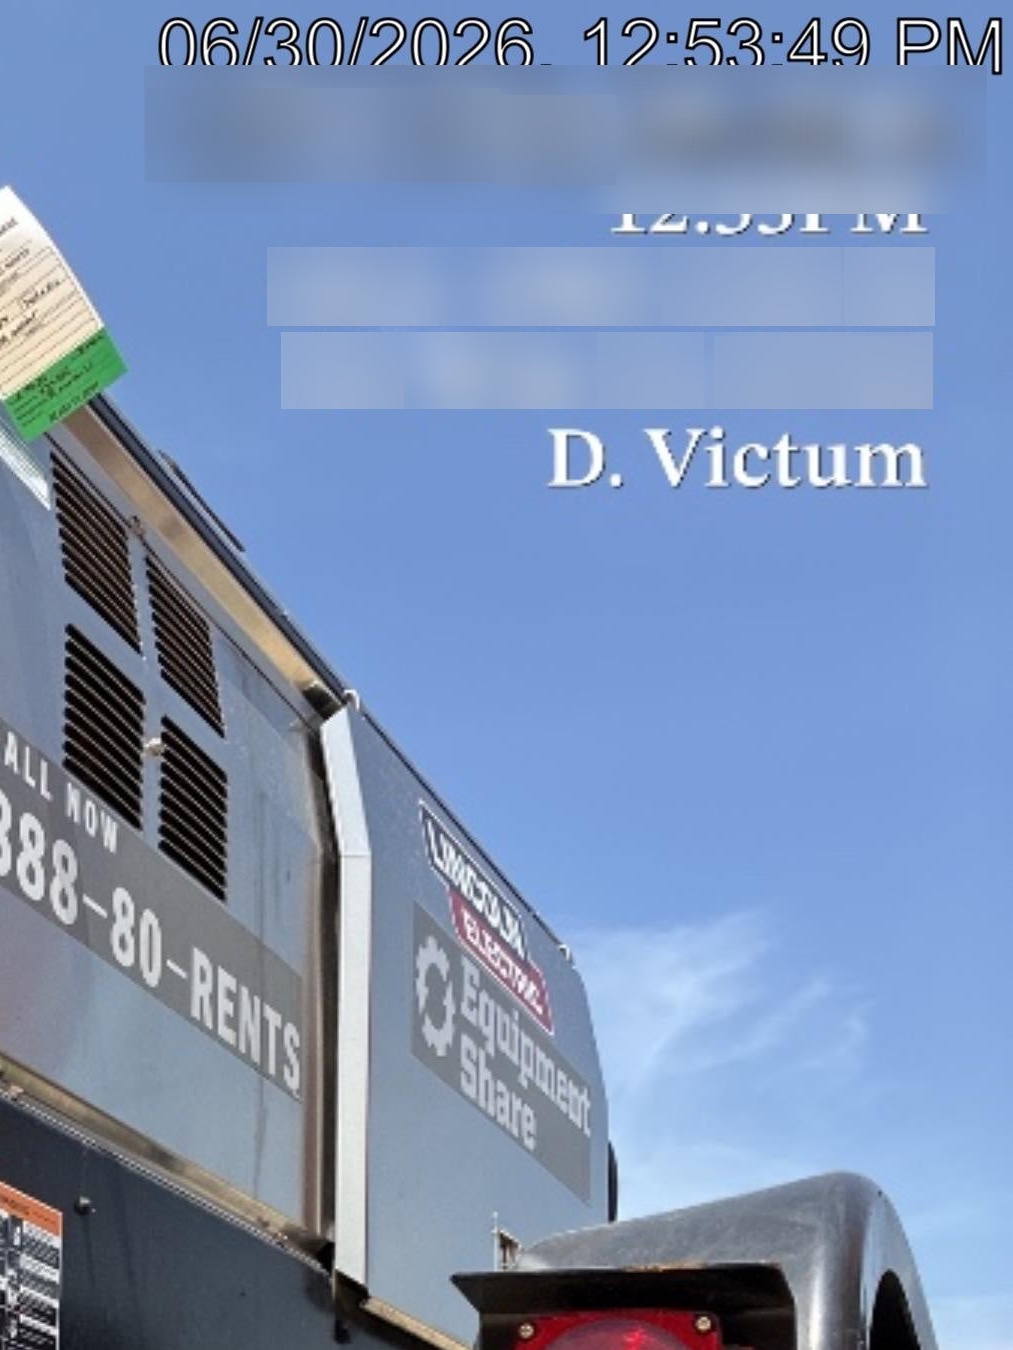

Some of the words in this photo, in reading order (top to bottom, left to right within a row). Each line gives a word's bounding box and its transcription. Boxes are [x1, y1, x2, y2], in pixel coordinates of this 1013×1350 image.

[67, 780, 119, 854] NOW
[426, 818, 527, 958] LINCOLN
[461, 907, 545, 1015] ELECTRIC
[460, 954, 591, 1138] Equipment
[460, 1034, 538, 1152] Share
